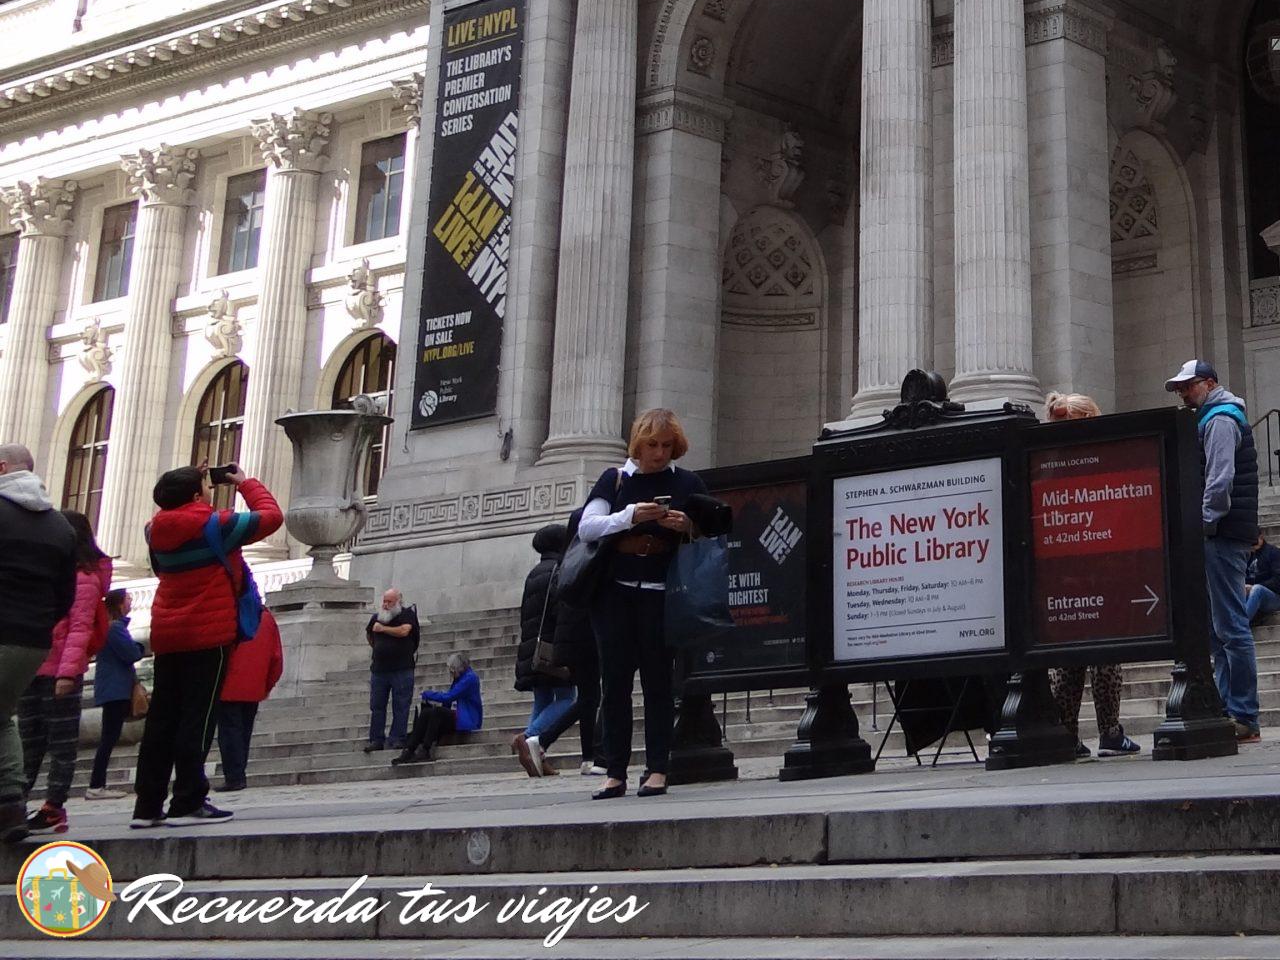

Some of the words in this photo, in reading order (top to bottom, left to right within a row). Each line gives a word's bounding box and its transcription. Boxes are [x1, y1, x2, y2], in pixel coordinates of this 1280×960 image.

[447, 19, 477, 47] LIVE
[483, 7, 518, 37] NYPL
[446, 58, 464, 77] THE
[465, 45, 511, 72] LIBRARY'S
[444, 72, 485, 97] PREMIER
[442, 84, 512, 117] CONVERSATION
[441, 114, 474, 137] SERIES
[453, 170, 504, 241] NYPL
[432, 204, 477, 265] LIVE
[426, 314, 455, 331] TICKETS
[455, 310, 472, 325] NOW
[425, 333, 435, 347] ON
[435, 330, 453, 345] SALE
[423, 341, 475, 362] NYPL.ORG/LIVE
[439, 394, 458, 403] Library
[1040, 460, 1066, 470] INTERIM
[1067, 456, 1100, 467] LOCATION
[845, 488, 879, 500] STEPHEN
[880, 487, 888, 496] A.
[889, 480, 945, 495] SCHWARZMAN
[946, 474, 986, 487] BUILDING
[1042, 484, 1153, 507] Mid-Manhattan
[771, 506, 804, 550] NYPL
[846, 517, 883, 541] The
[890, 513, 936, 536] New
[943, 503, 990, 529] York
[1043, 510, 1094, 528] Library
[759, 524, 788, 562] LIVE
[1043, 534, 1053, 545] at
[1056, 531, 1080, 543] 42nd
[1083, 529, 1112, 541] Street
[847, 542, 907, 570] Public
[914, 537, 990, 564] Library
[739, 572, 761, 588] WITH
[847, 589, 870, 597] Monday,
[872, 586, 899, 595] Thursday,
[921, 581, 949, 590] Saturday:
[728, 589, 768, 606] RIGHTEST
[847, 601, 870, 609] Tuesday,
[872, 598, 906, 606] Wednesday:
[1047, 594, 1104, 610] Entrance
[1058, 612, 1077, 621] 42nd
[1078, 611, 1100, 620] Street
